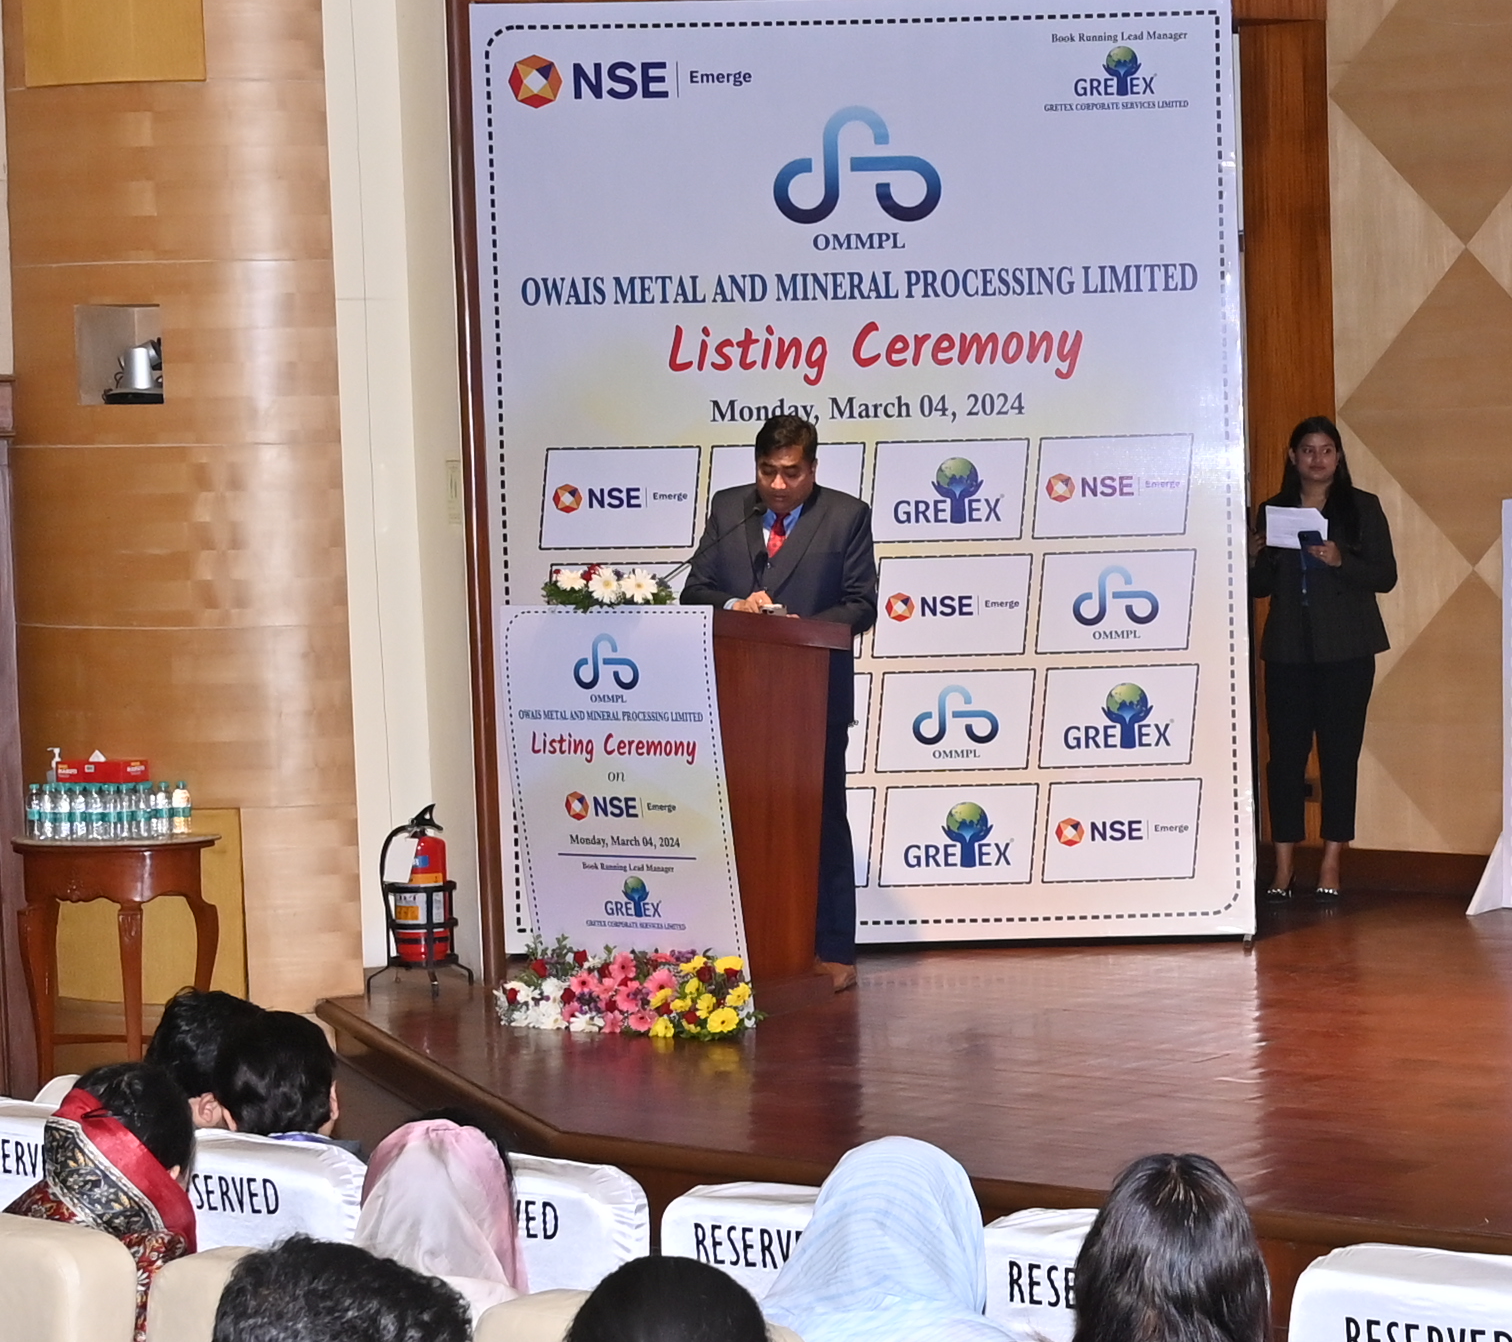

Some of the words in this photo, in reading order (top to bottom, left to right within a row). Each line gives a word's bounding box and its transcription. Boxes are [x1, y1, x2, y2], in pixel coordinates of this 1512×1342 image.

[1051, 32, 1076, 44] Book
[1078, 31, 1119, 44] Running
[1120, 30, 1144, 42] Lead
[1146, 30, 1188, 42] Manager
[572, 62, 669, 99] NSE
[689, 70, 753, 87] Emerge
[812, 232, 906, 251] OMMPL
[520, 276, 607, 307] OWAIS
[612, 274, 707, 305] METAL
[711, 273, 768, 303] AND
[774, 271, 899, 301] MINERAL
[904, 267, 1076, 298] PROCESSING
[1081, 263, 1198, 293] LIMITED
[668, 325, 828, 386] Listing
[852, 321, 1083, 379] Ceremony
[828, 394, 912, 420] March
[919, 394, 957, 424] 04,
[966, 392, 1025, 417] 2024
[587, 487, 642, 509] NSE
[531, 731, 594, 763] Listing
[603, 733, 697, 765] Ceremony
[932, 748, 981, 759] OMMPL
[607, 771, 625, 783] on
[592, 795, 639, 818] NSE
[1090, 819, 1144, 842] NSE
[191, 1172, 280, 1215] SERVED
[693, 1222, 802, 1271] RESERV
